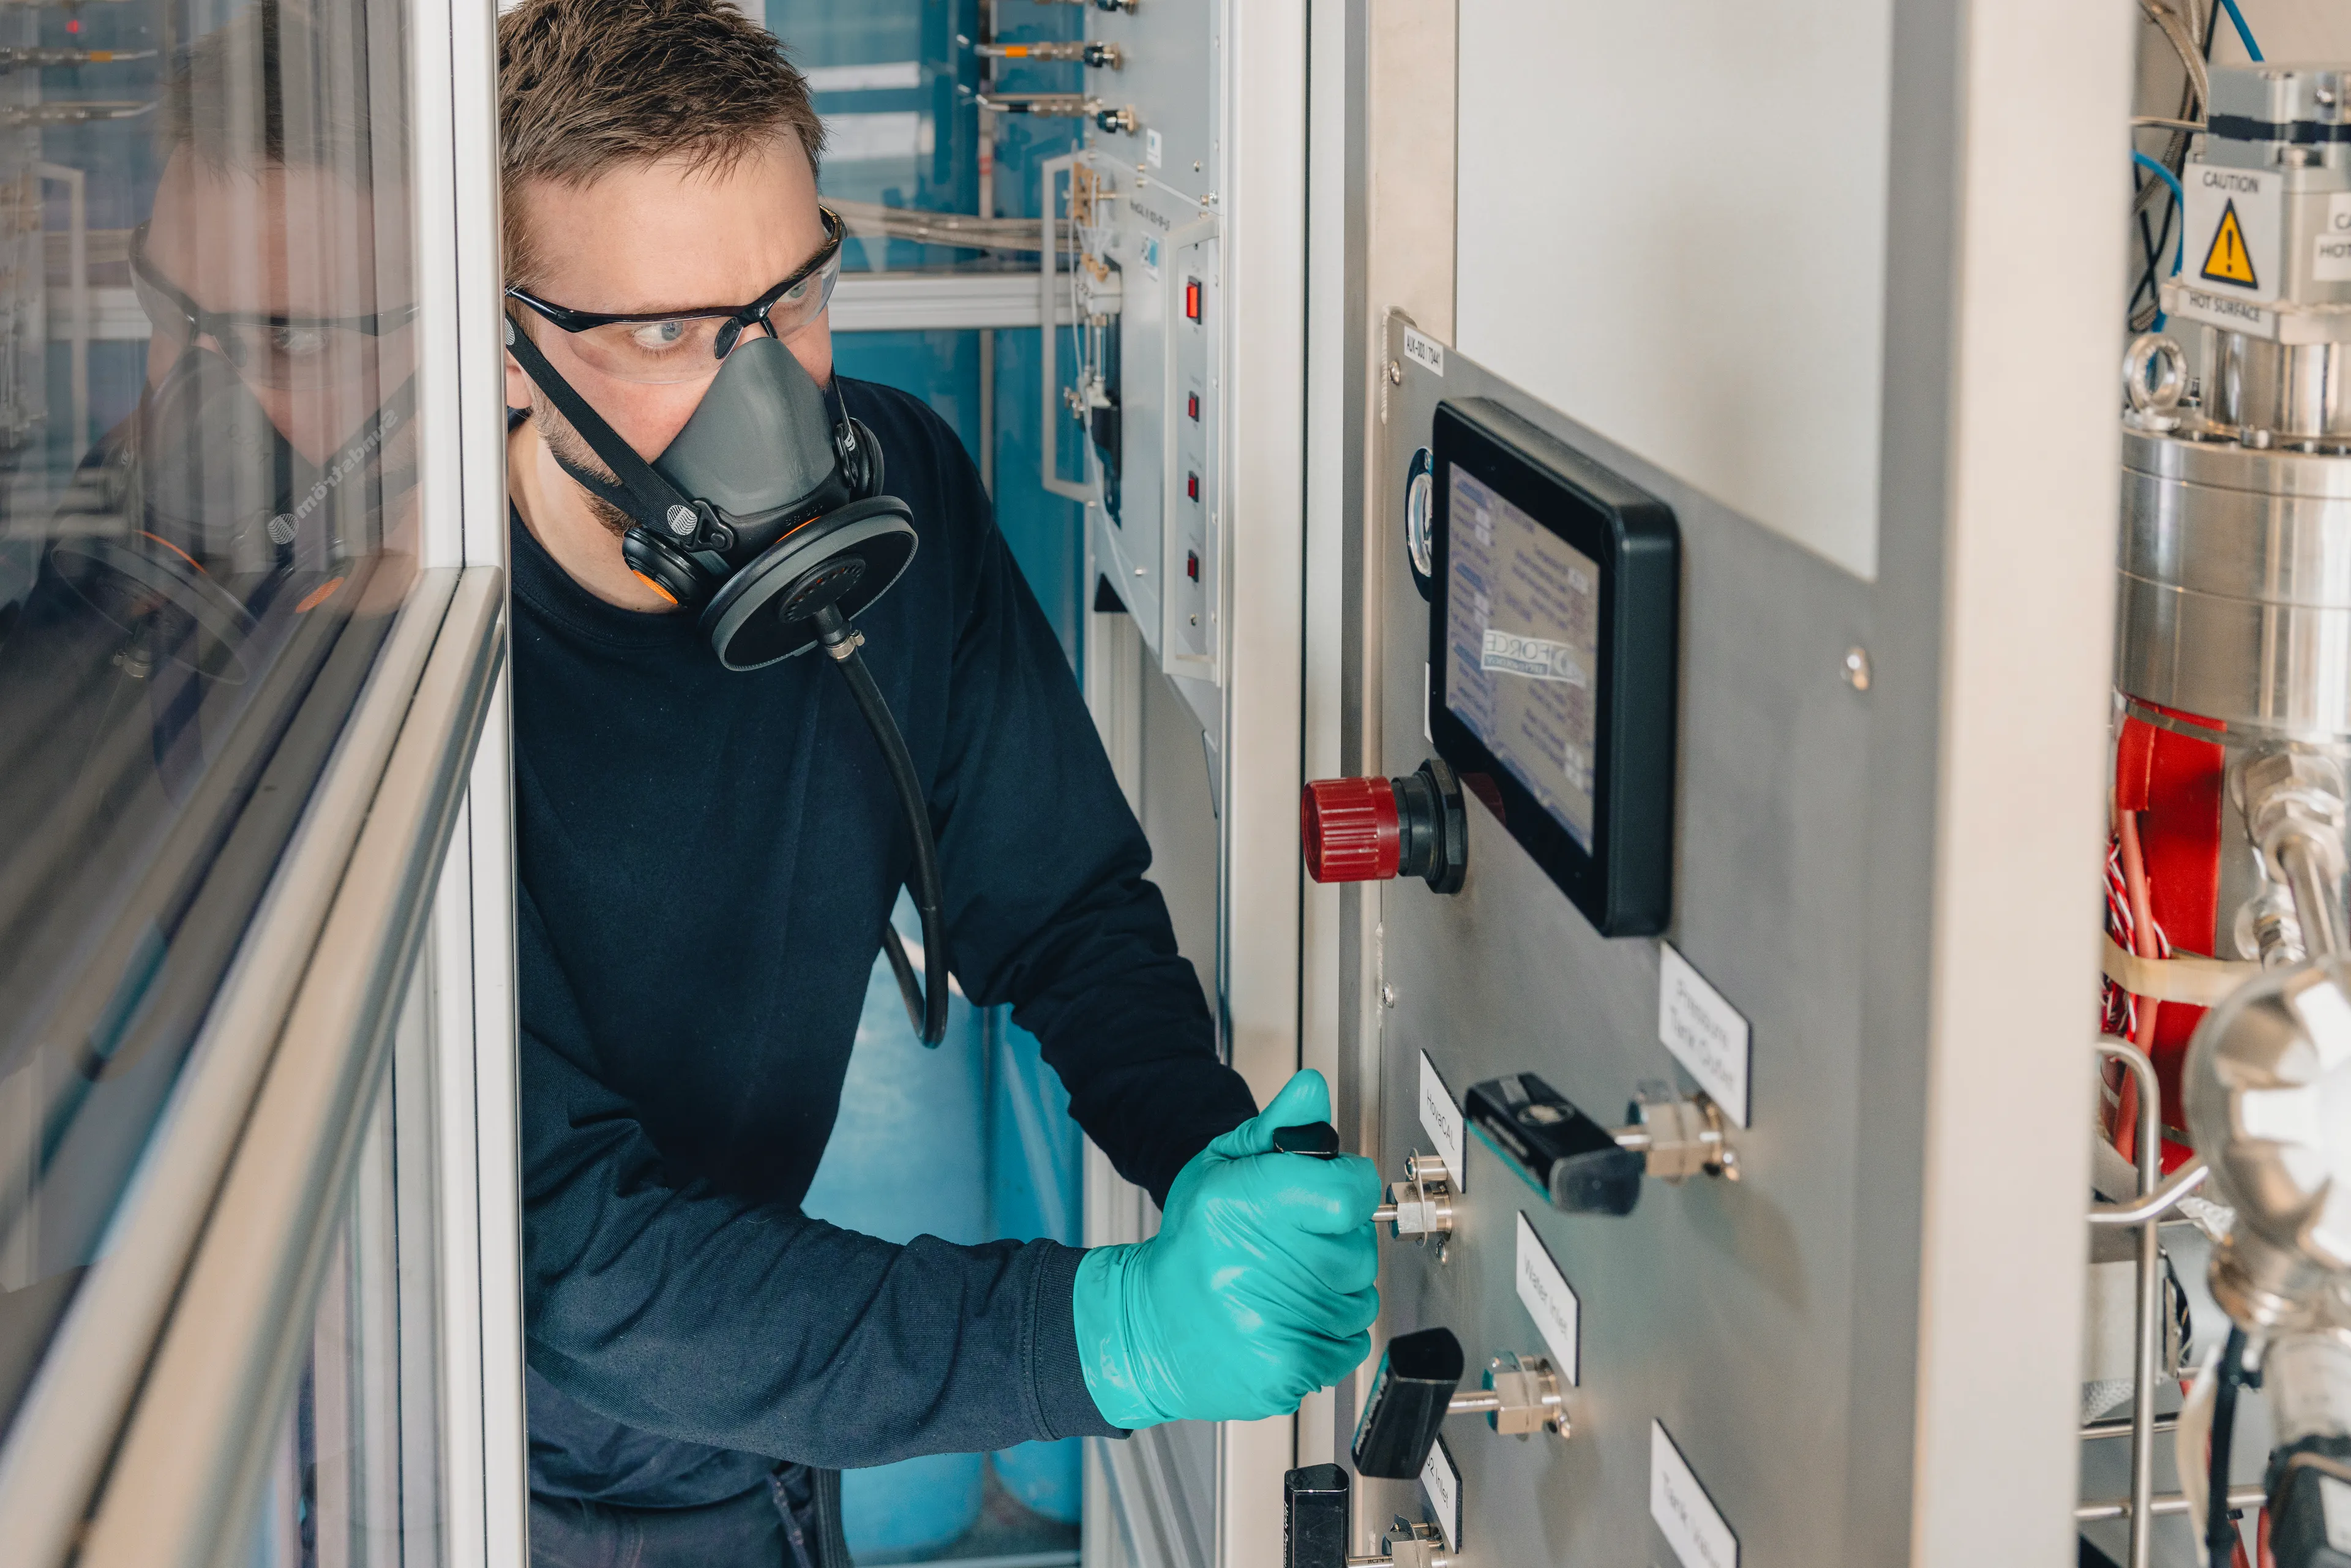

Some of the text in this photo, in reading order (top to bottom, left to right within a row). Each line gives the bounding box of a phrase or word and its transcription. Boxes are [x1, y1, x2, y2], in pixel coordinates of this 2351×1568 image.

[2202, 170, 2259, 193] CAUTION
[2189, 292, 2260, 323] HOT SURFACE
[1427, 1089, 1455, 1150] HovaCAL
[1524, 1253, 1548, 1305] Water
[1436, 1468, 1449, 1509] Inlet
